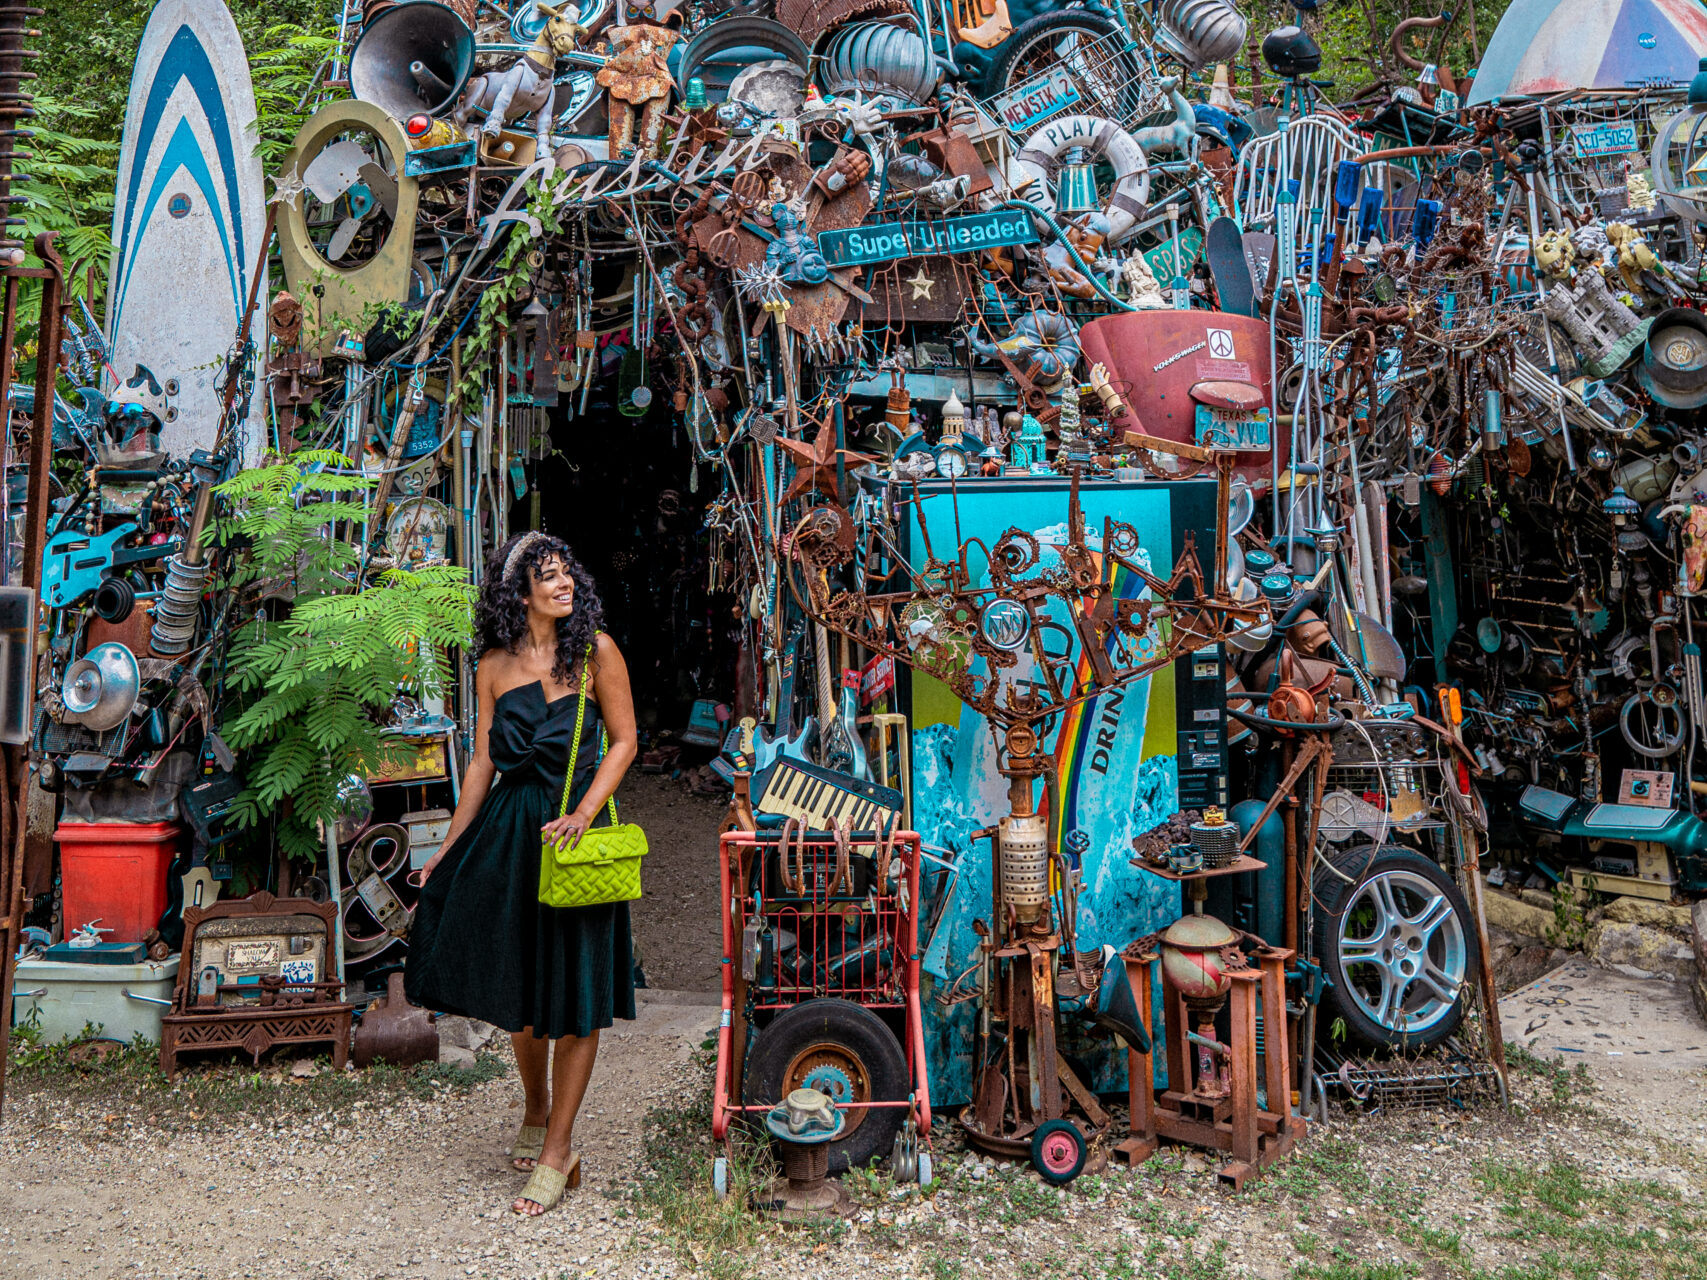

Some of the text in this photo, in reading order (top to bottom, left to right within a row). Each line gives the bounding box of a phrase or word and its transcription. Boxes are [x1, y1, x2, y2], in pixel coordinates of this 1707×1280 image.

[1003, 78, 1074, 128] MEWSIK 2
[1044, 119, 1097, 147] PLAY
[1576, 128, 1635, 150] CCD-5052
[849, 214, 1031, 257] Super Unleaded
[1152, 340, 1207, 373] VOLKSWAGEN
[1217, 410, 1248, 422] TEXAS
[412, 440, 434, 451] 5352
[1090, 648, 1134, 776] DRINS
